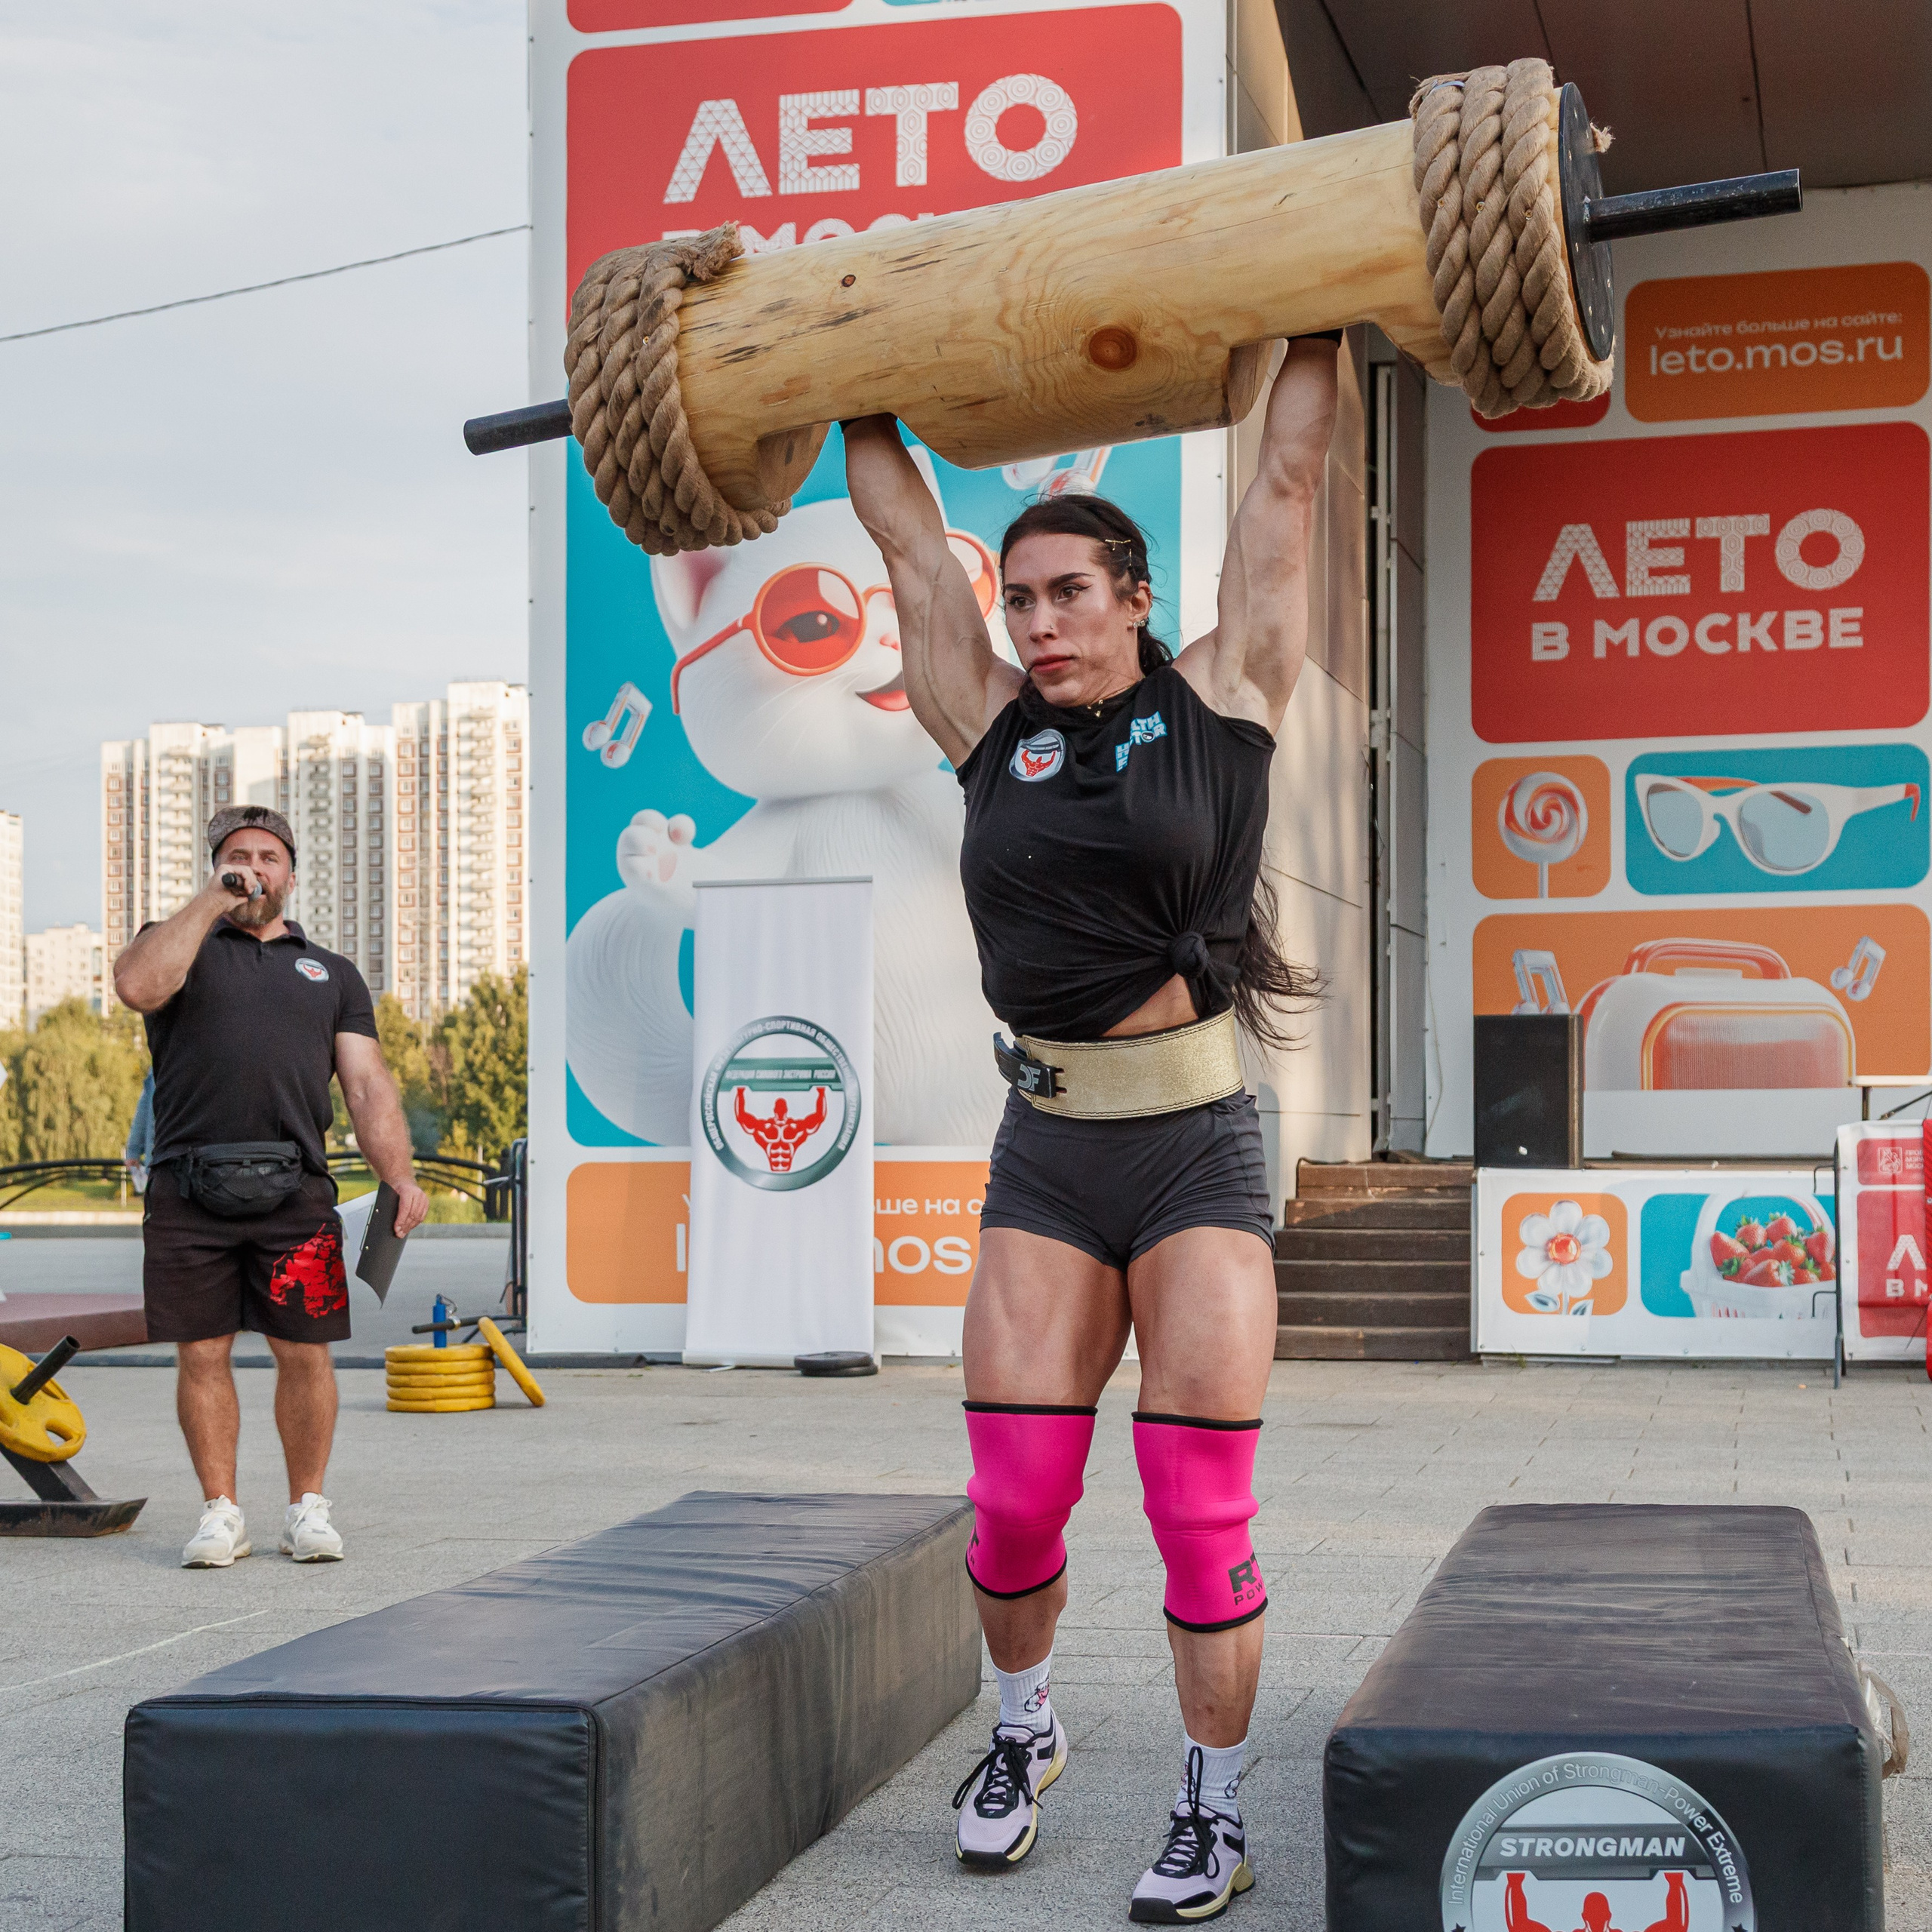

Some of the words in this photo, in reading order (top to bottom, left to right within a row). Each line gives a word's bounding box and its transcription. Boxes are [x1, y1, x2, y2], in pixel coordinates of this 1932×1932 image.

[663, 73, 1078, 204] ЛЕТО
[1655, 322, 1733, 339] Узнайте
[1737, 318, 1810, 334] больше
[1814, 315, 1838, 328] на
[1841, 310, 1903, 328] сайте:
[1650, 335, 1903, 376] leto.mos.ru
[1532, 508, 1866, 601] ЛЕТО
[1531, 621, 1570, 661] В
[1593, 607, 1863, 659] МОСКВЕ
[924, 1198, 960, 1215] на
[1448, 1804, 1498, 1906] International
[1492, 1777, 1541, 1810] Union
[1542, 1765, 1559, 1784] of
[1706, 1831, 1743, 1903] Extreme
[1500, 1836, 1685, 1857] STRONGMAN
